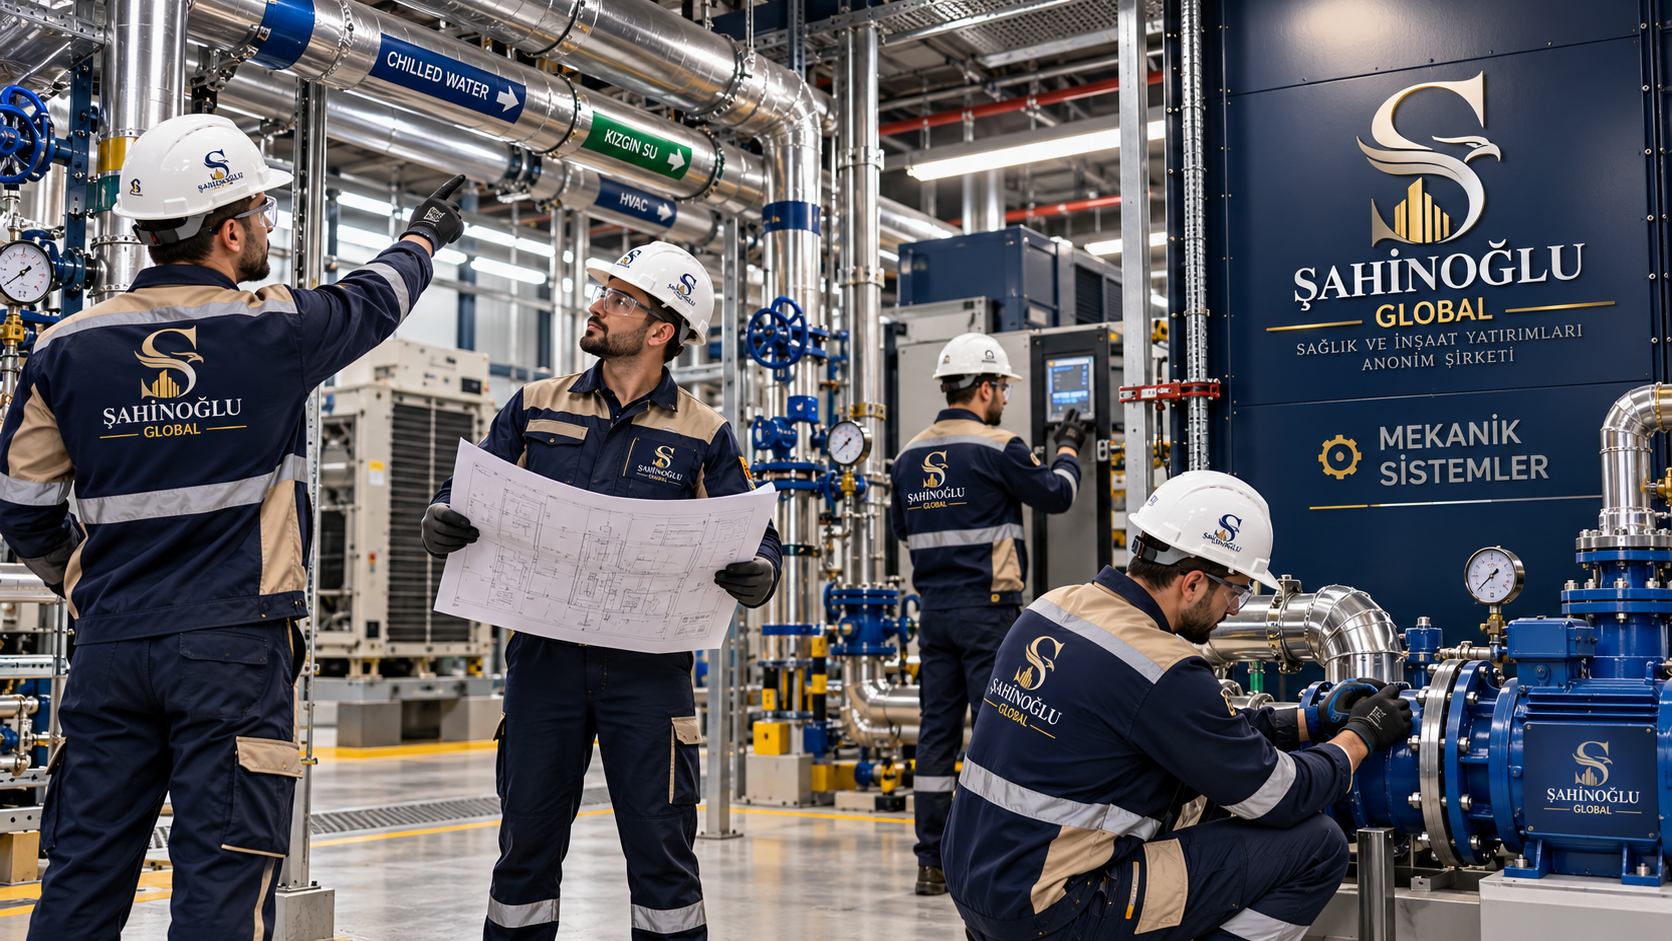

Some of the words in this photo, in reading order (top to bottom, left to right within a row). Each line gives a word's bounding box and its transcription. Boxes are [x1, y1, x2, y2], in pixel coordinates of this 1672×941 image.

[387, 51, 443, 83] CHILLED
[445, 70, 490, 100] WATER
[604, 129, 641, 154] KIZGIN
[642, 143, 658, 159] SU
[620, 192, 648, 213] HVAC
[1293, 239, 1586, 311] ŞAHİNOĞLU
[1375, 297, 1494, 328] GLOBAL
[1296, 338, 1358, 356] SAĞLIK
[1365, 337, 1387, 352] VE
[1394, 331, 1458, 351] İNŞAAT
[1466, 323, 1583, 344] YATIRIMLARI
[1361, 352, 1435, 371] ANONİM
[1445, 346, 1515, 368] ŞİRKETİ
[103, 396, 242, 429] ŞAHİNOĞLU
[143, 423, 201, 438] GLOBAL
[1379, 413, 1522, 451] MEKANİK
[1380, 454, 1550, 486] SİSTEMLER
[907, 486, 965, 505] ŞAHİNOĞLU
[990, 678, 1063, 725] ŞAHİNOĞLU
[998, 703, 1028, 727] GLOBAL
[1546, 786, 1640, 804] ŞAHİNOĞLU
[1573, 804, 1612, 815] GLOBAL
